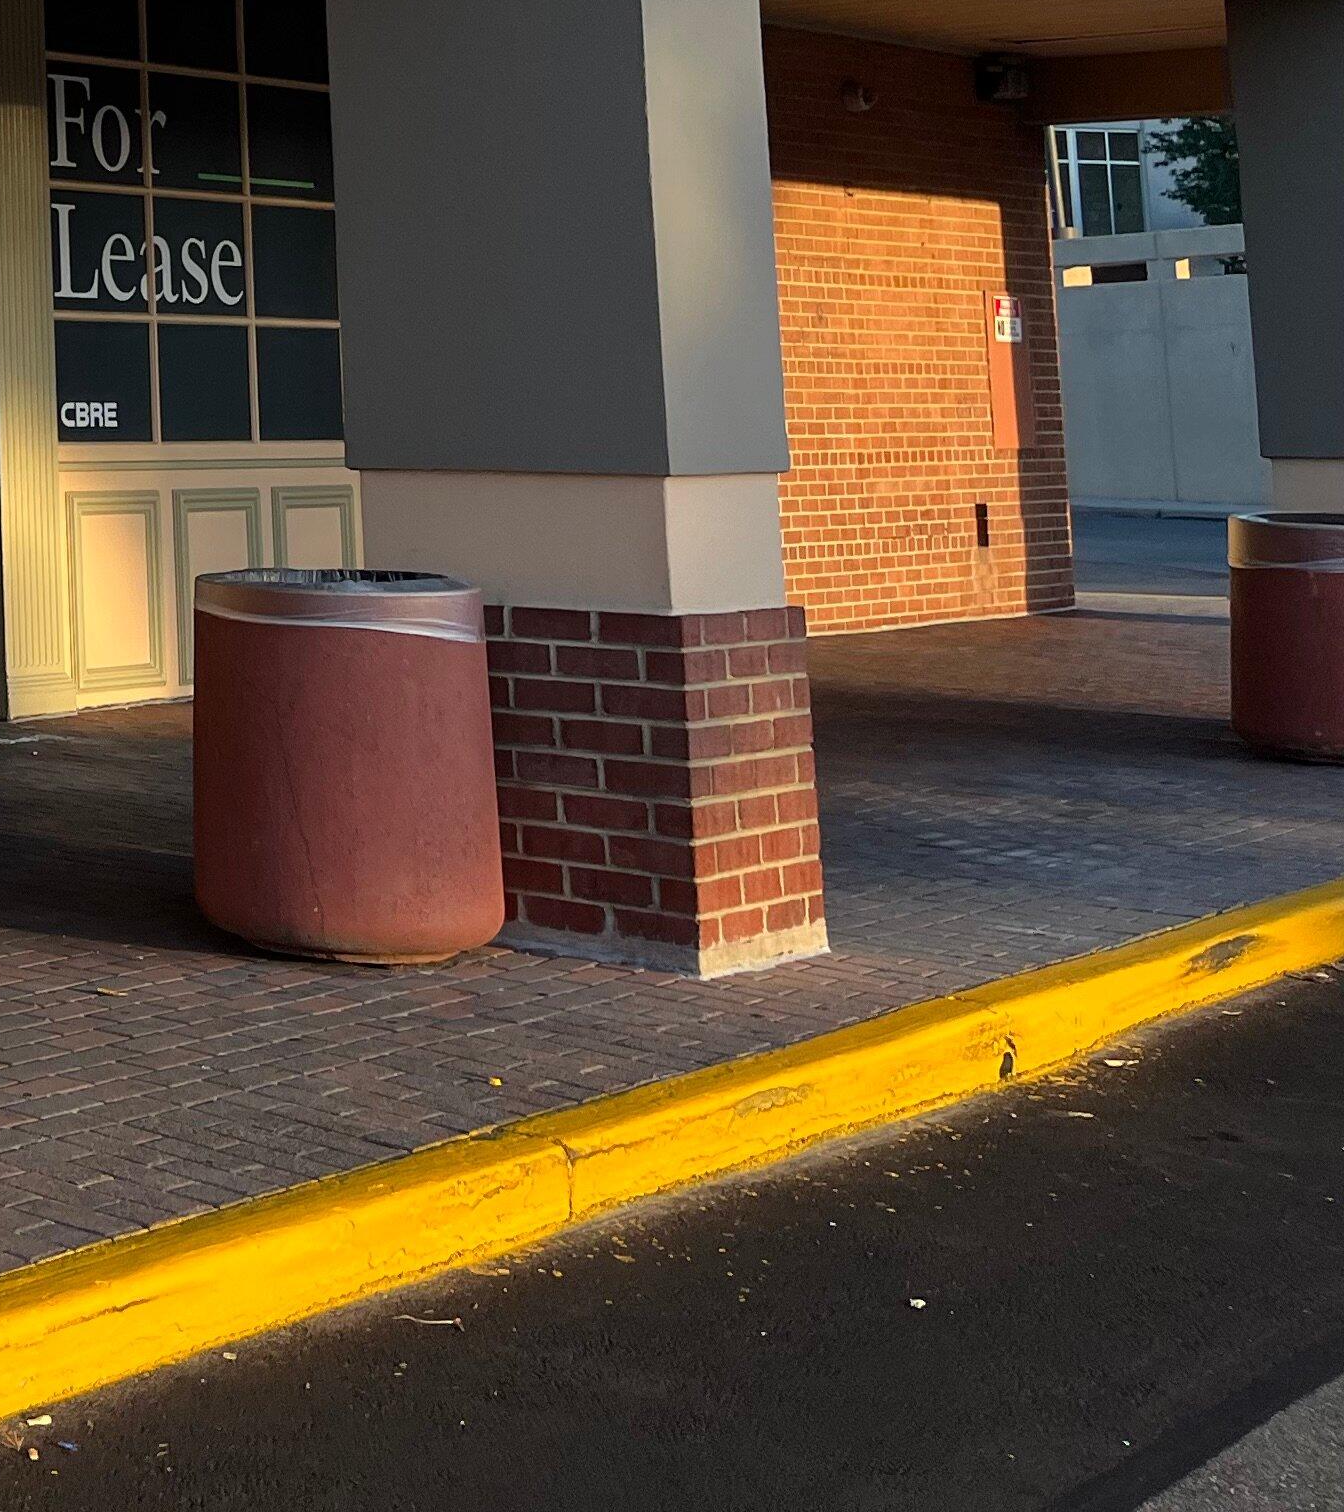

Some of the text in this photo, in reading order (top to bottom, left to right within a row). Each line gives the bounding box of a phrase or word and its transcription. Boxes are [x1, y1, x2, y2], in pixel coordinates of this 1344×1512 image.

[47, 73, 167, 175] For
[50, 203, 244, 305] Lease
[60, 401, 118, 428] CBRE
